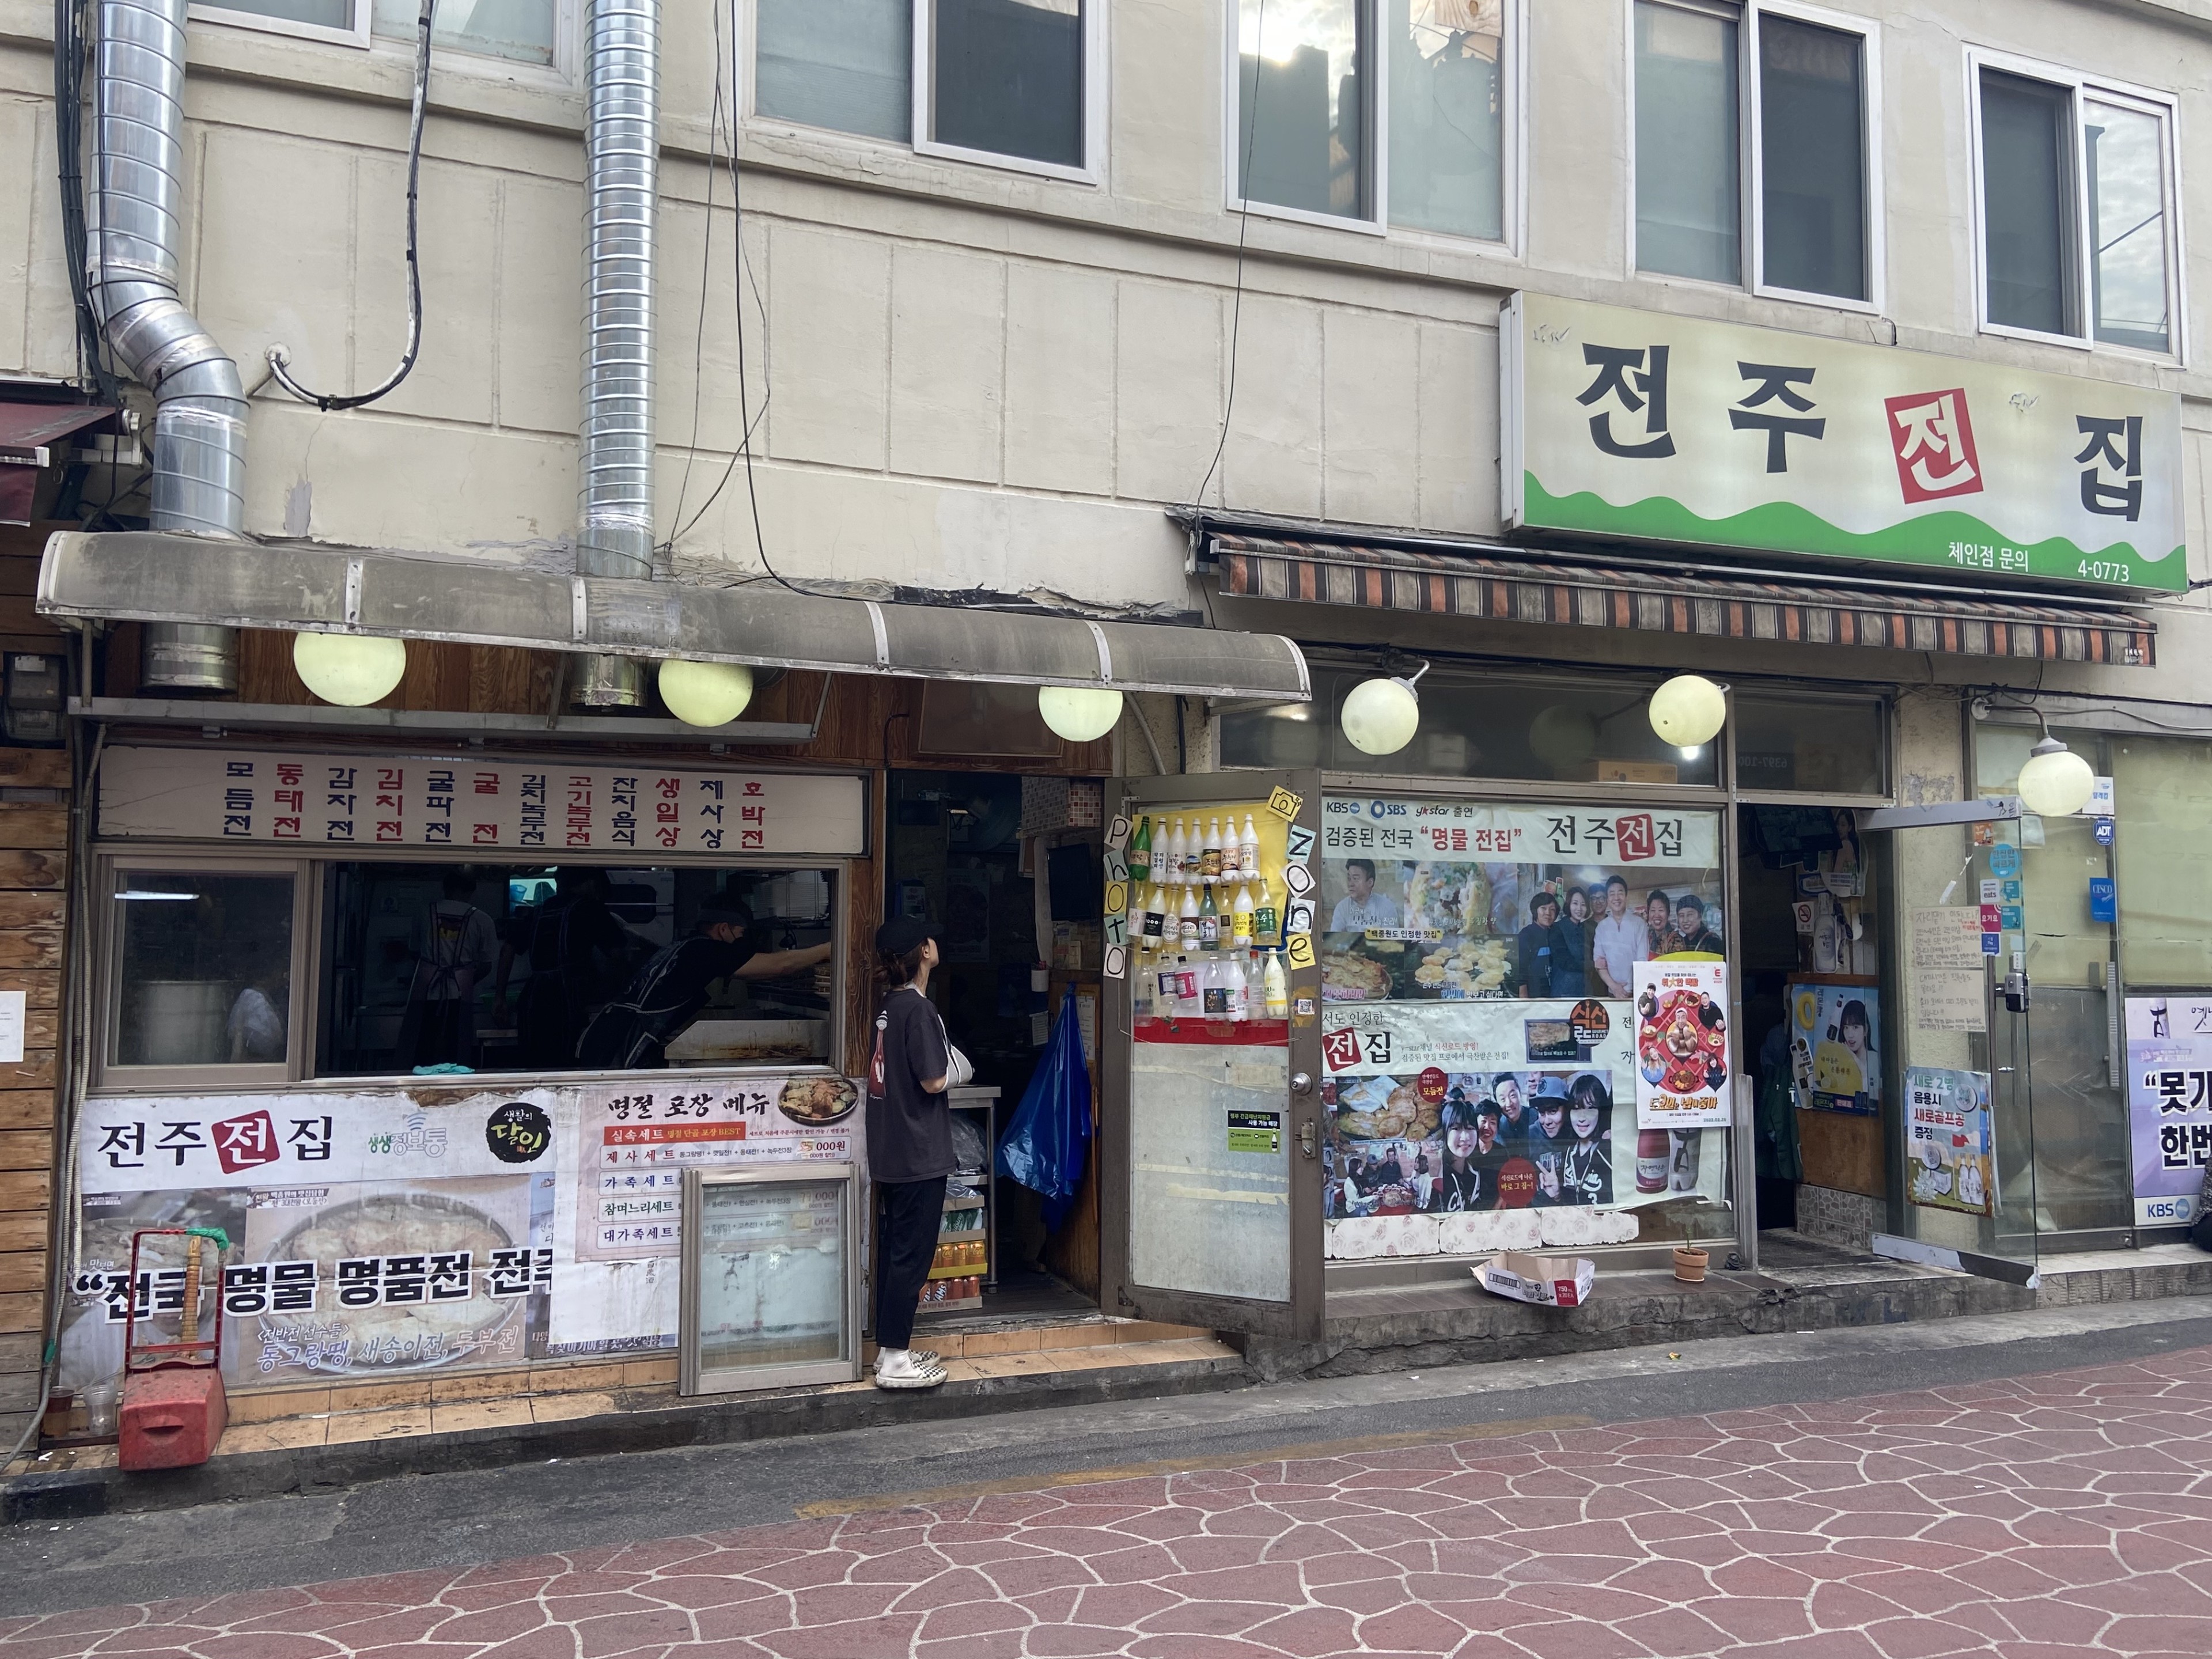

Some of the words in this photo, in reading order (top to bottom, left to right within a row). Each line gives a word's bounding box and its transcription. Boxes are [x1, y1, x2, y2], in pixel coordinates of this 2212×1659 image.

[1948, 542, 1993, 568] 체인점
[1999, 548, 2028, 573] 문의
[2078, 559, 2130, 582] 4-0773
[224, 762, 253, 836] 모듬전
[273, 763, 304, 838] 동태전
[327, 767, 357, 840] 감자전
[376, 768, 403, 841] 김치전
[425, 770, 454, 842] 굴파전
[520, 774, 547, 846] 김치녹두전
[566, 775, 593, 847] 고기녹두전
[612, 777, 637, 847] 잔치음식
[655, 778, 680, 847] 생일상
[1326, 802, 1349, 813] KBS
[1387, 804, 1407, 815] SBS
[1453, 806, 1473, 817] 출연
[700, 779, 724, 849] 제사상
[741, 782, 765, 849] 호박전
[1325, 826, 1374, 848] 검증된
[1380, 828, 1414, 849] 전국
[1546, 815, 1682, 857] 전주전집
[2096, 827, 2111, 836] ADT
[2093, 885, 2112, 894] CESCO
[1466, 991, 1484, 999] 맛보고
[1486, 990, 1503, 999] 싶다면
[1350, 1012, 1384, 1024] 인정한
[1571, 1001, 1607, 1028] 식신
[1574, 1025, 1592, 1040] 로드
[1402, 1054, 1422, 1062] 검증된
[1423, 1053, 1437, 1062] 맛집
[1438, 1052, 1464, 1061] 프로에서
[1466, 1052, 1493, 1060] 극찬받은
[1494, 1052, 1509, 1060] 전집!
[1423, 1086, 1444, 1096] 모듬전
[1914, 1074, 1933, 1088] 새로
[1936, 1077, 1954, 1091] 2병
[608, 1094, 654, 1120] 명절
[664, 1093, 713, 1118] 포장
[724, 1093, 770, 1116] 메뉴
[1914, 1092, 1941, 1105] 음용시
[503, 1109, 532, 1123] 생활의
[1914, 1108, 1965, 1127] 새로골프공
[97, 1116, 333, 1168] 전주전집
[491, 1122, 542, 1153] 달인
[611, 1128, 664, 1142] 실속세트
[667, 1130, 682, 1138] 명절
[684, 1129, 699, 1138] 단골
[701, 1128, 717, 1137] 포장
[718, 1128, 741, 1136] BEST
[1914, 1126, 1933, 1140] 증정
[1501, 1183, 1513, 1191] 바로
[604, 1200, 674, 1215] 참며느리세트
[2147, 1203, 2174, 1217] KBS
[604, 1226, 673, 1243] 대가족세트
[225, 1263, 317, 1316] 명물
[339, 1251, 471, 1306] 명품전
[452, 1325, 518, 1356] 두부전
